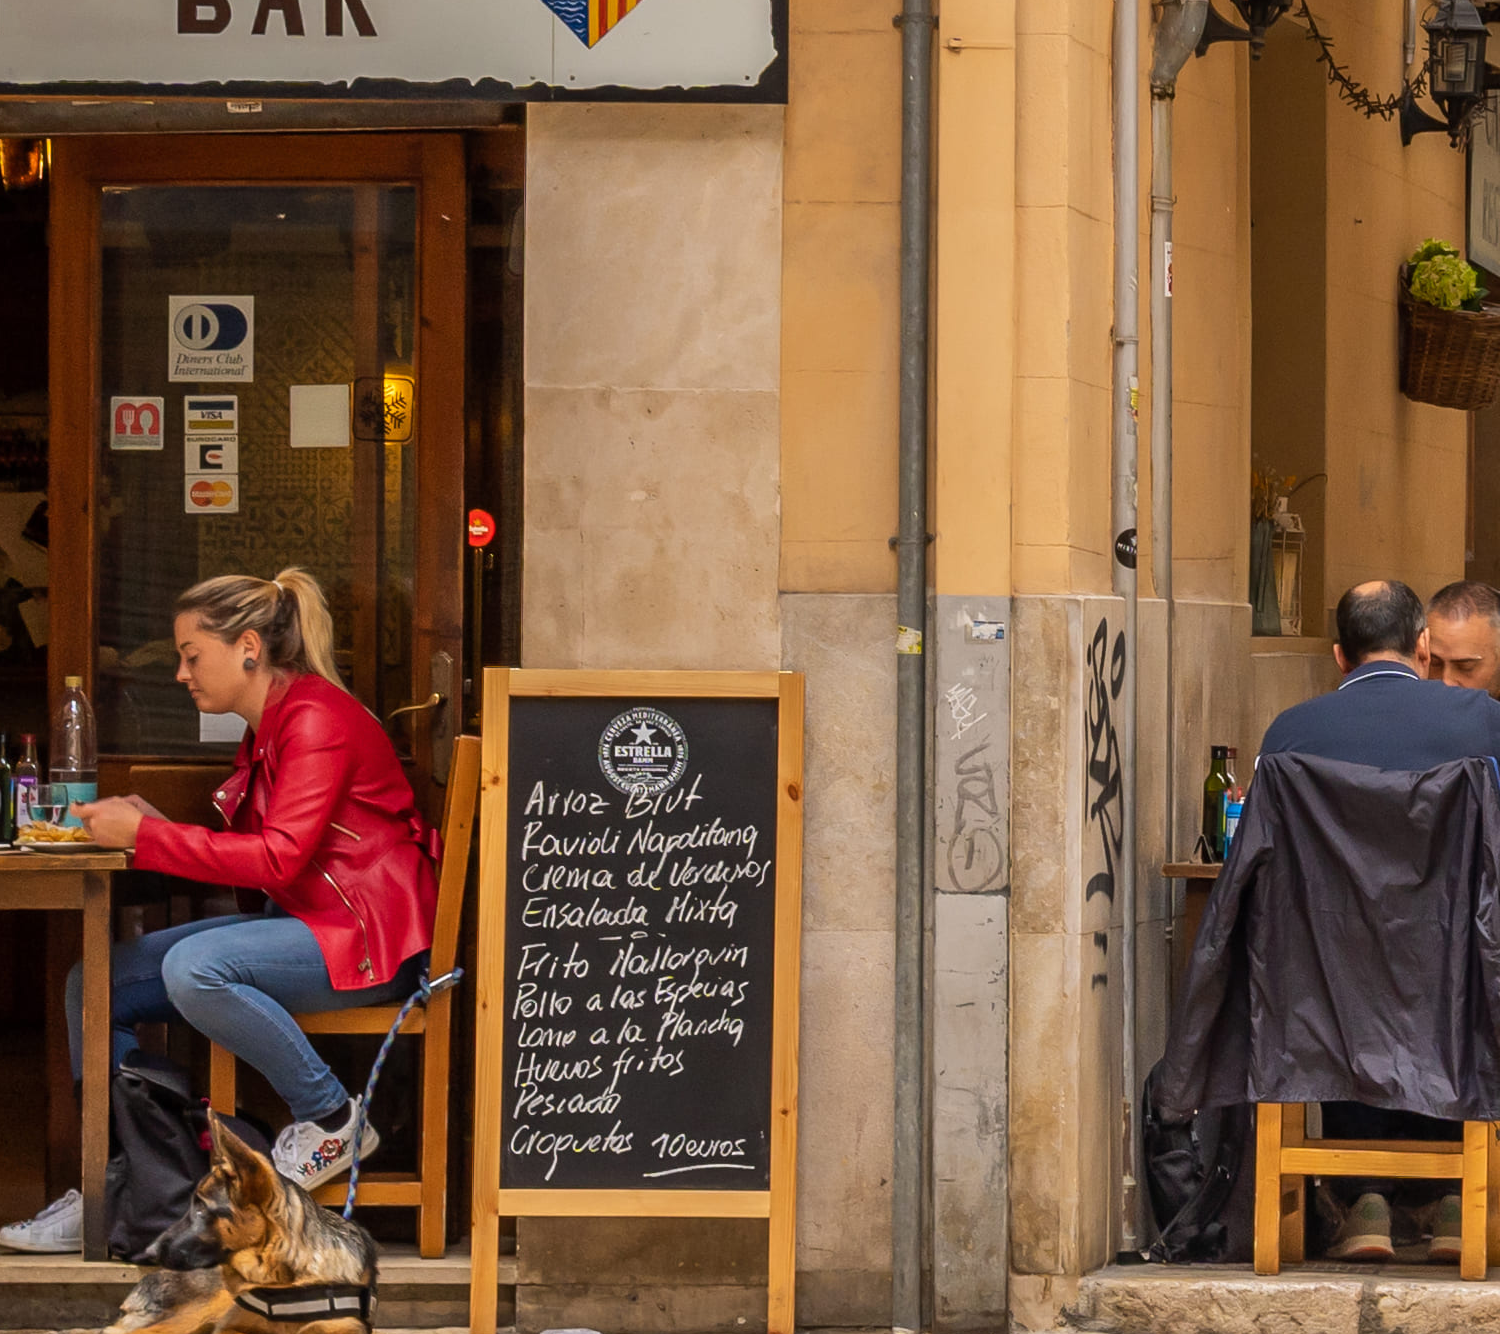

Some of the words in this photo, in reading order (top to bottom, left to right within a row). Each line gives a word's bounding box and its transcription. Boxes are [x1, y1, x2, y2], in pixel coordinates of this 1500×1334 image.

[174, 365, 246, 377] International
[176, 353, 212, 365] Diners
[216, 353, 244, 365] Club
[200, 411, 223, 420] VISA
[614, 745, 672, 758] ESTRELLA
[524, 780, 610, 816] Arroz
[625, 773, 703, 819] Brut
[521, 821, 621, 861] Ravioli
[522, 863, 616, 892] Crema
[627, 864, 661, 891] de
[522, 896, 649, 929] Ensalada
[665, 884, 739, 929] Mixta
[517, 942, 589, 980] Frito
[513, 982, 572, 1020] Pollo
[586, 994, 603, 1012] a
[610, 984, 647, 1010] las
[518, 1022, 577, 1048] Lomo
[590, 1026, 611, 1046] a
[617, 1017, 646, 1045] la
[656, 1008, 745, 1048] Plancha
[514, 1052, 603, 1088] Huevos
